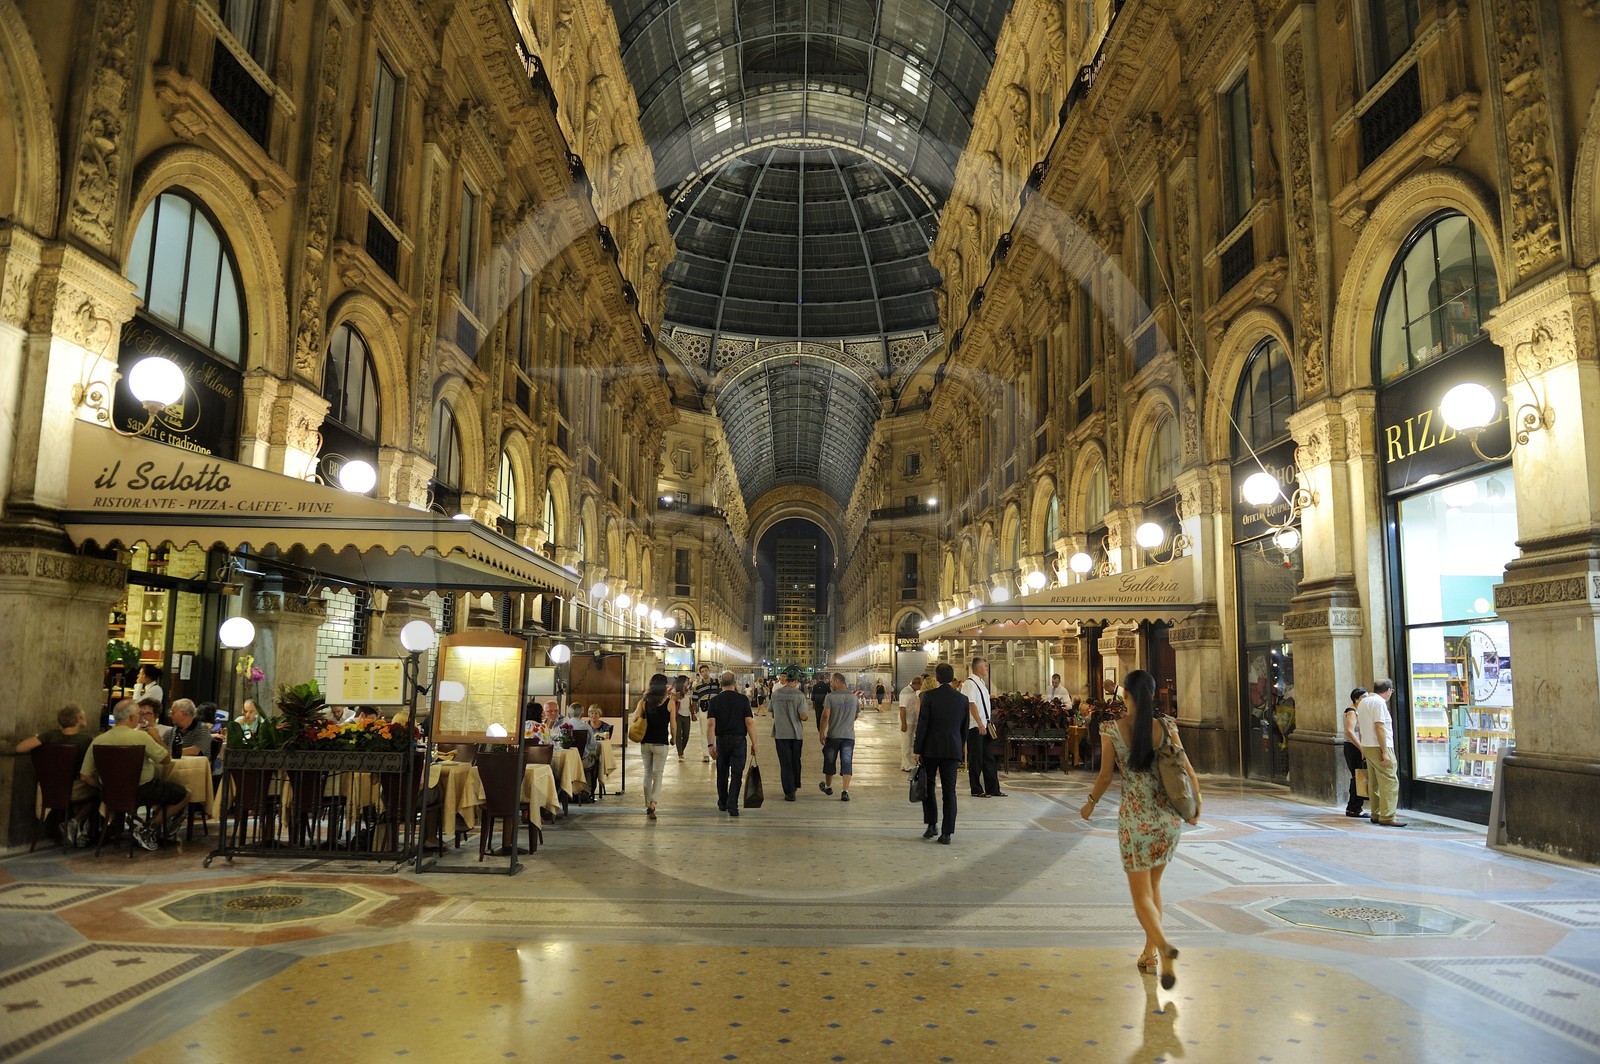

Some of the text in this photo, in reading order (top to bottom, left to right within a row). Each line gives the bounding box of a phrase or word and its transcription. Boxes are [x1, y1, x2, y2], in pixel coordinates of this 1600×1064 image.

[195, 362, 235, 398] Milano
[160, 431, 166, 441] e
[168, 435, 211, 455] tradizione
[94, 460, 231, 492] il Salotto
[93, 497, 177, 509] RISTORANTE
[188, 499, 226, 511] PIZZA
[297, 502, 333, 513] WINE
[1118, 575, 1179, 593] Galleria
[1158, 595, 1181, 603] PIZZA
